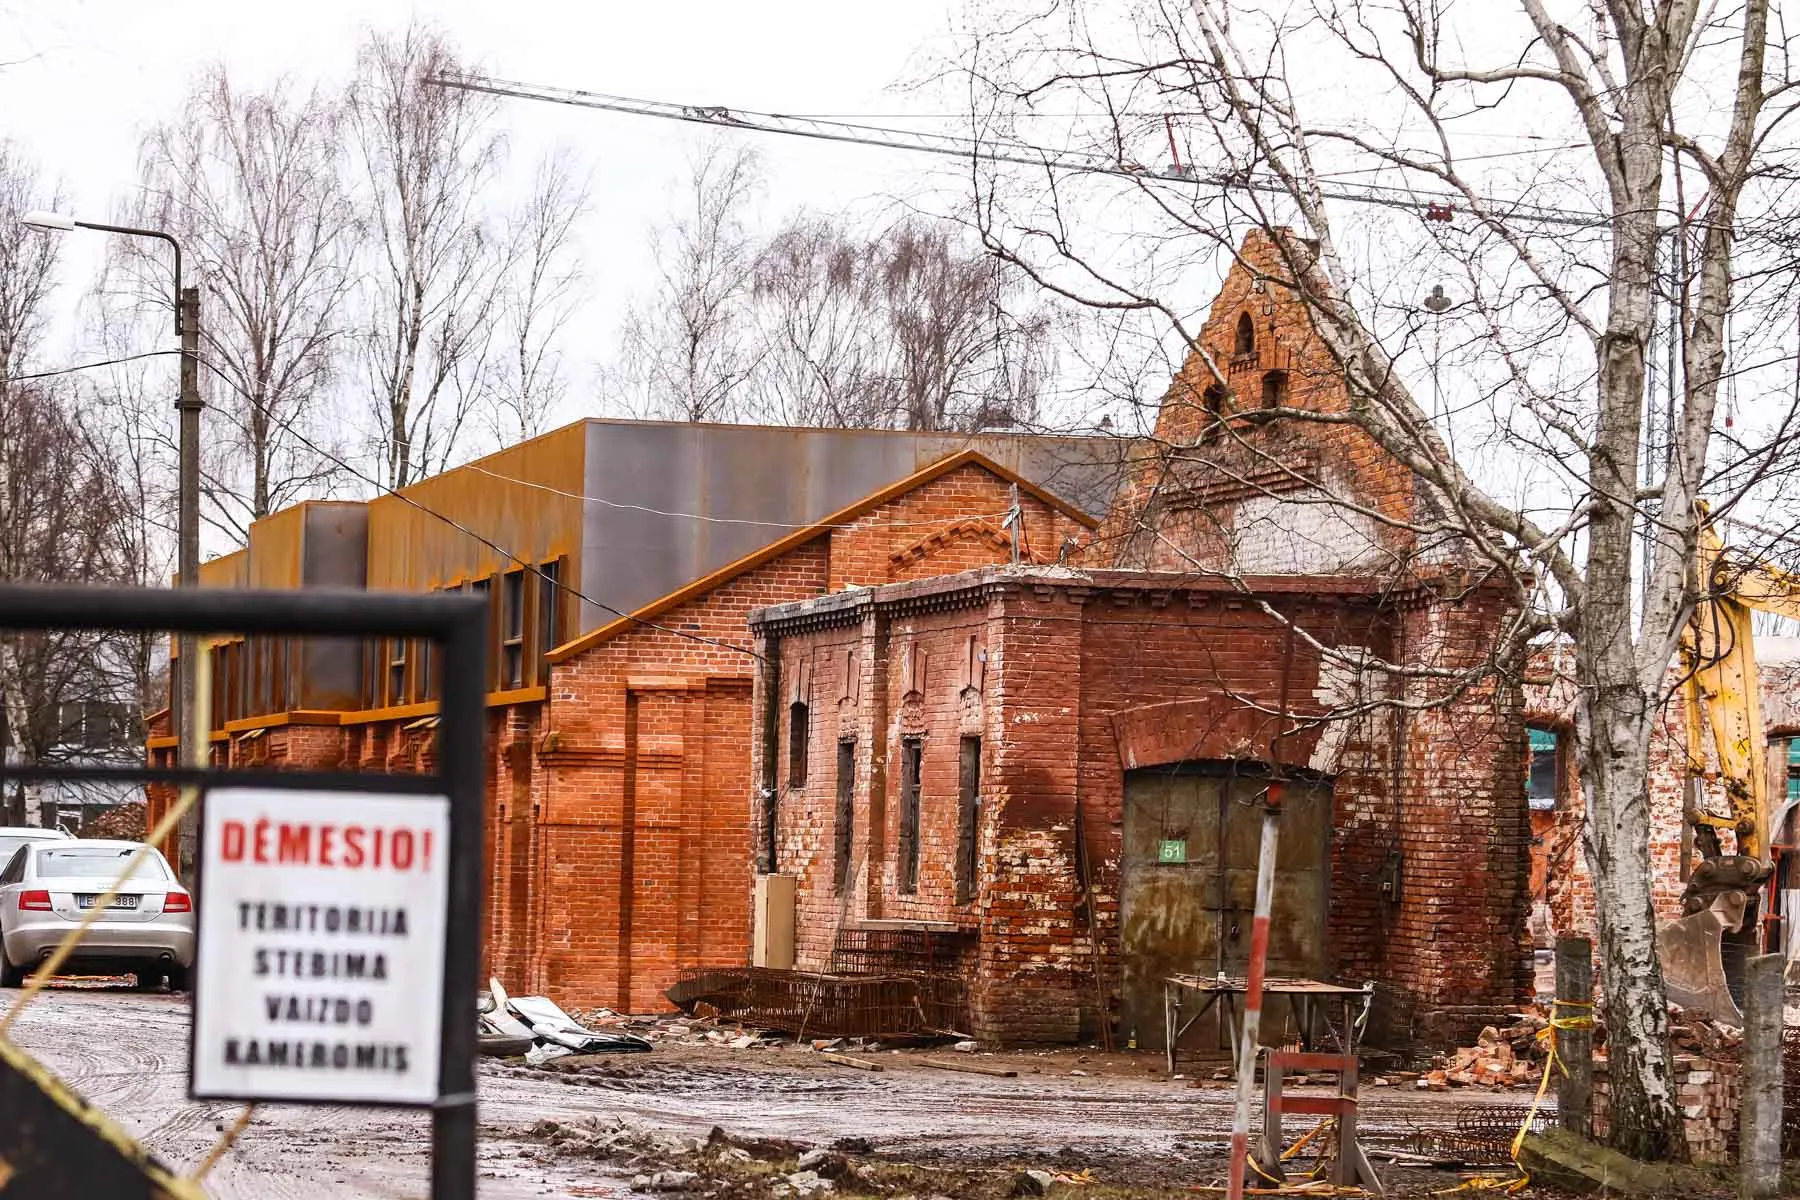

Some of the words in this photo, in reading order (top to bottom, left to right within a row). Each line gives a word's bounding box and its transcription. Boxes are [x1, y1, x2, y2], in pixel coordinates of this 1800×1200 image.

[1165, 841, 1180, 858] 51
[237, 901, 409, 936] TERITORIJA
[254, 949, 388, 981] STEBIMA
[265, 996, 372, 1026] VAIZDO
[223, 1037, 410, 1074] KAMEROMIS
